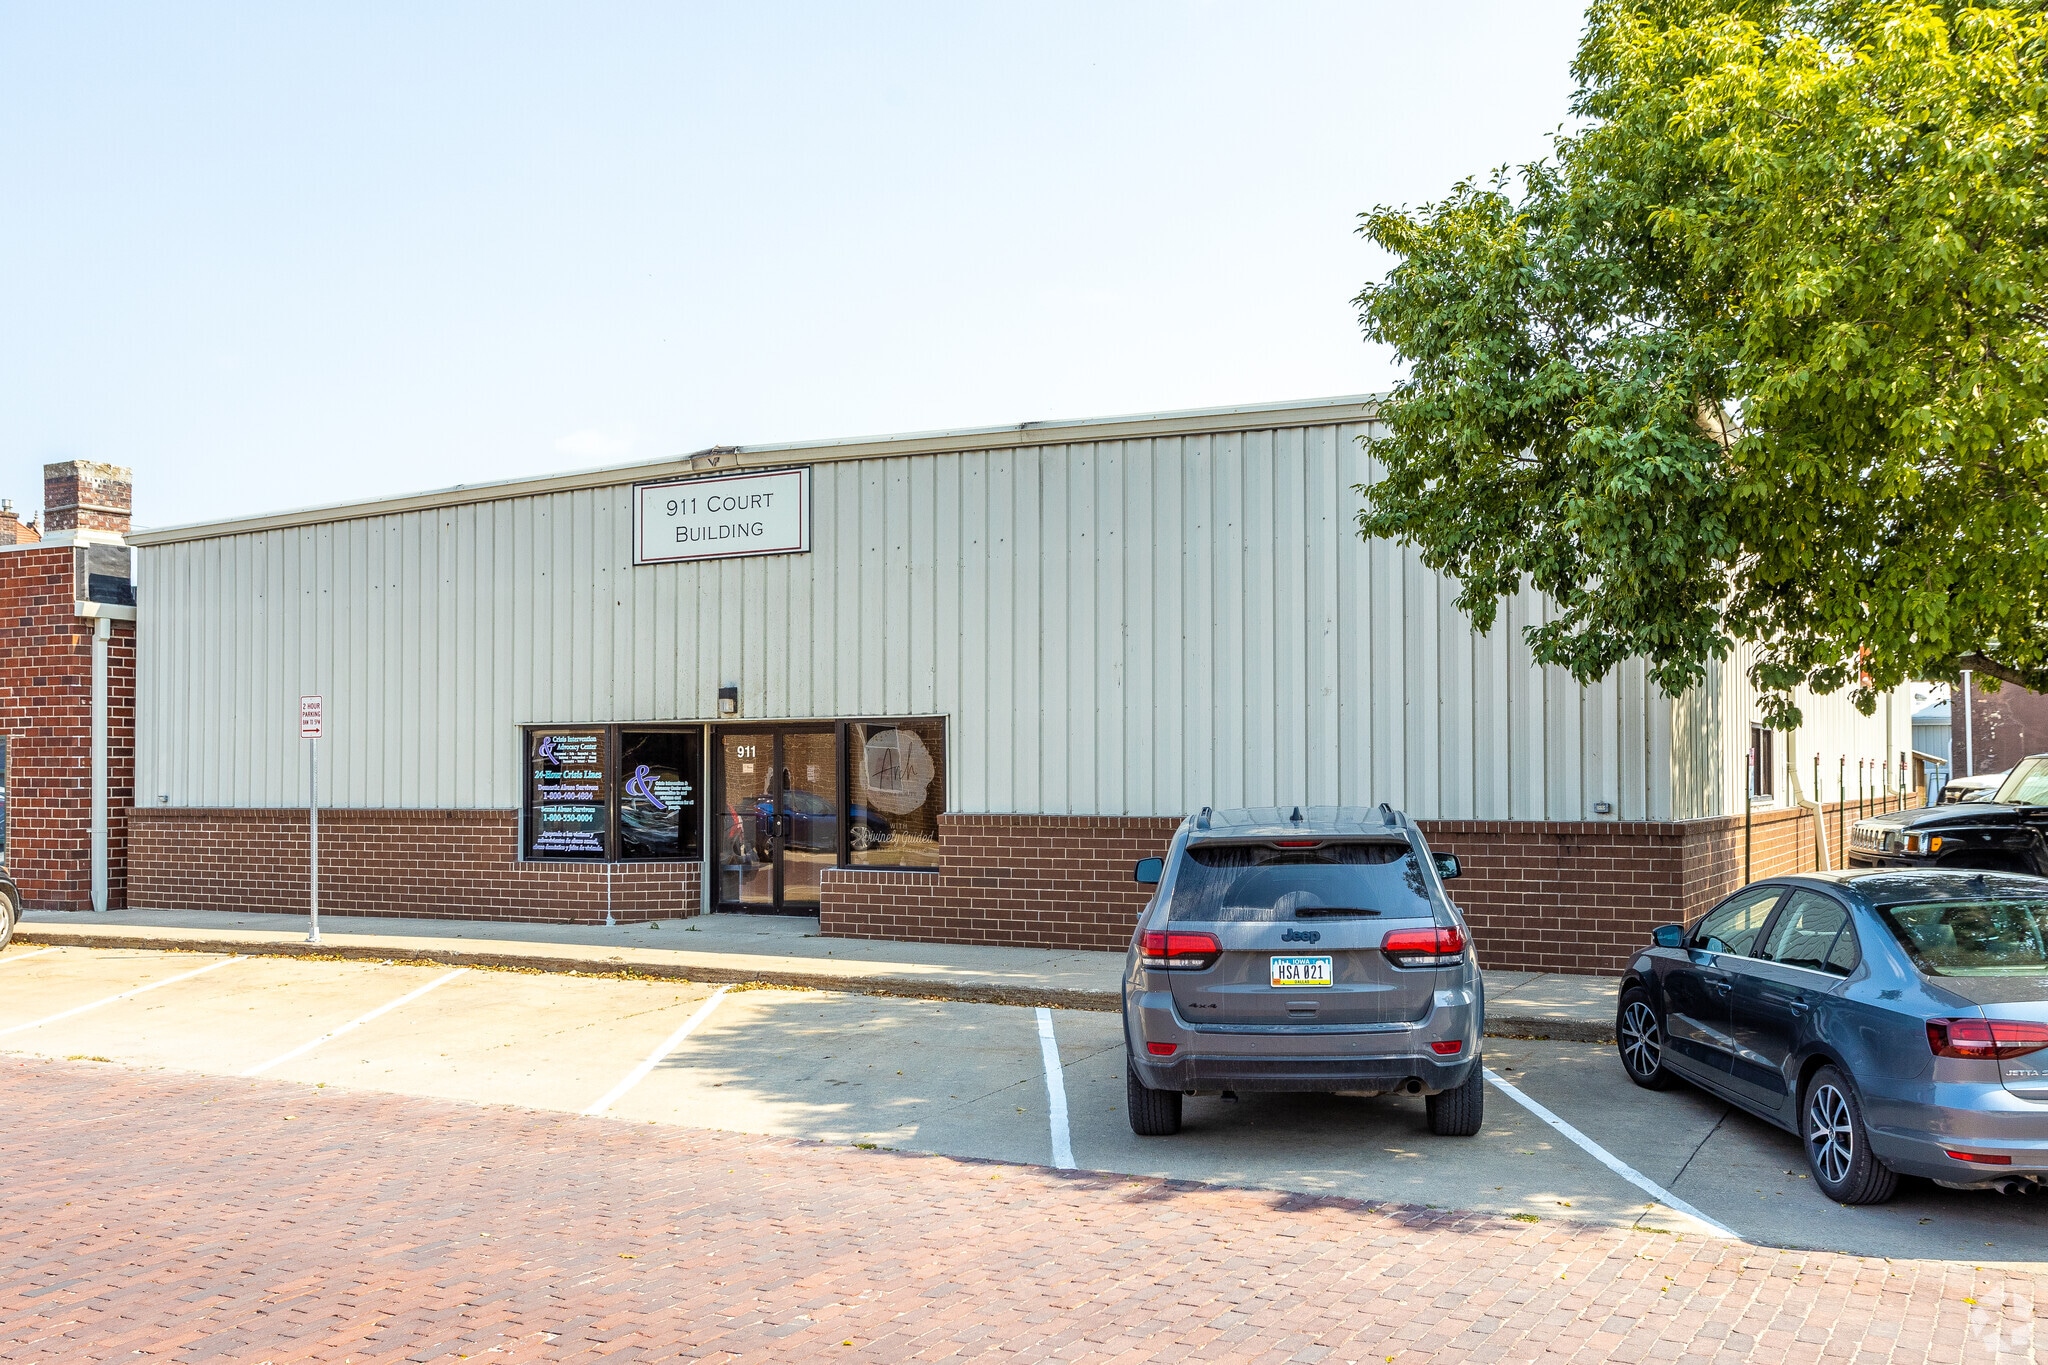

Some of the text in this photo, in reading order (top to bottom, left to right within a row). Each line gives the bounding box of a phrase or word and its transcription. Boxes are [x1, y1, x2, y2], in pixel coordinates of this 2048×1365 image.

[666, 493, 774, 517] 911 COURT
[676, 522, 764, 543] BUILDING
[557, 743, 580, 751] Advocacy
[736, 745, 756, 758] 911
[534, 770, 602, 779] 24-Hour Crisis Lines
[889, 822, 908, 830] WITH
[901, 830, 935, 848] Guided
[1281, 928, 1321, 944] Jeep
[1278, 965, 1300, 980] HSA
